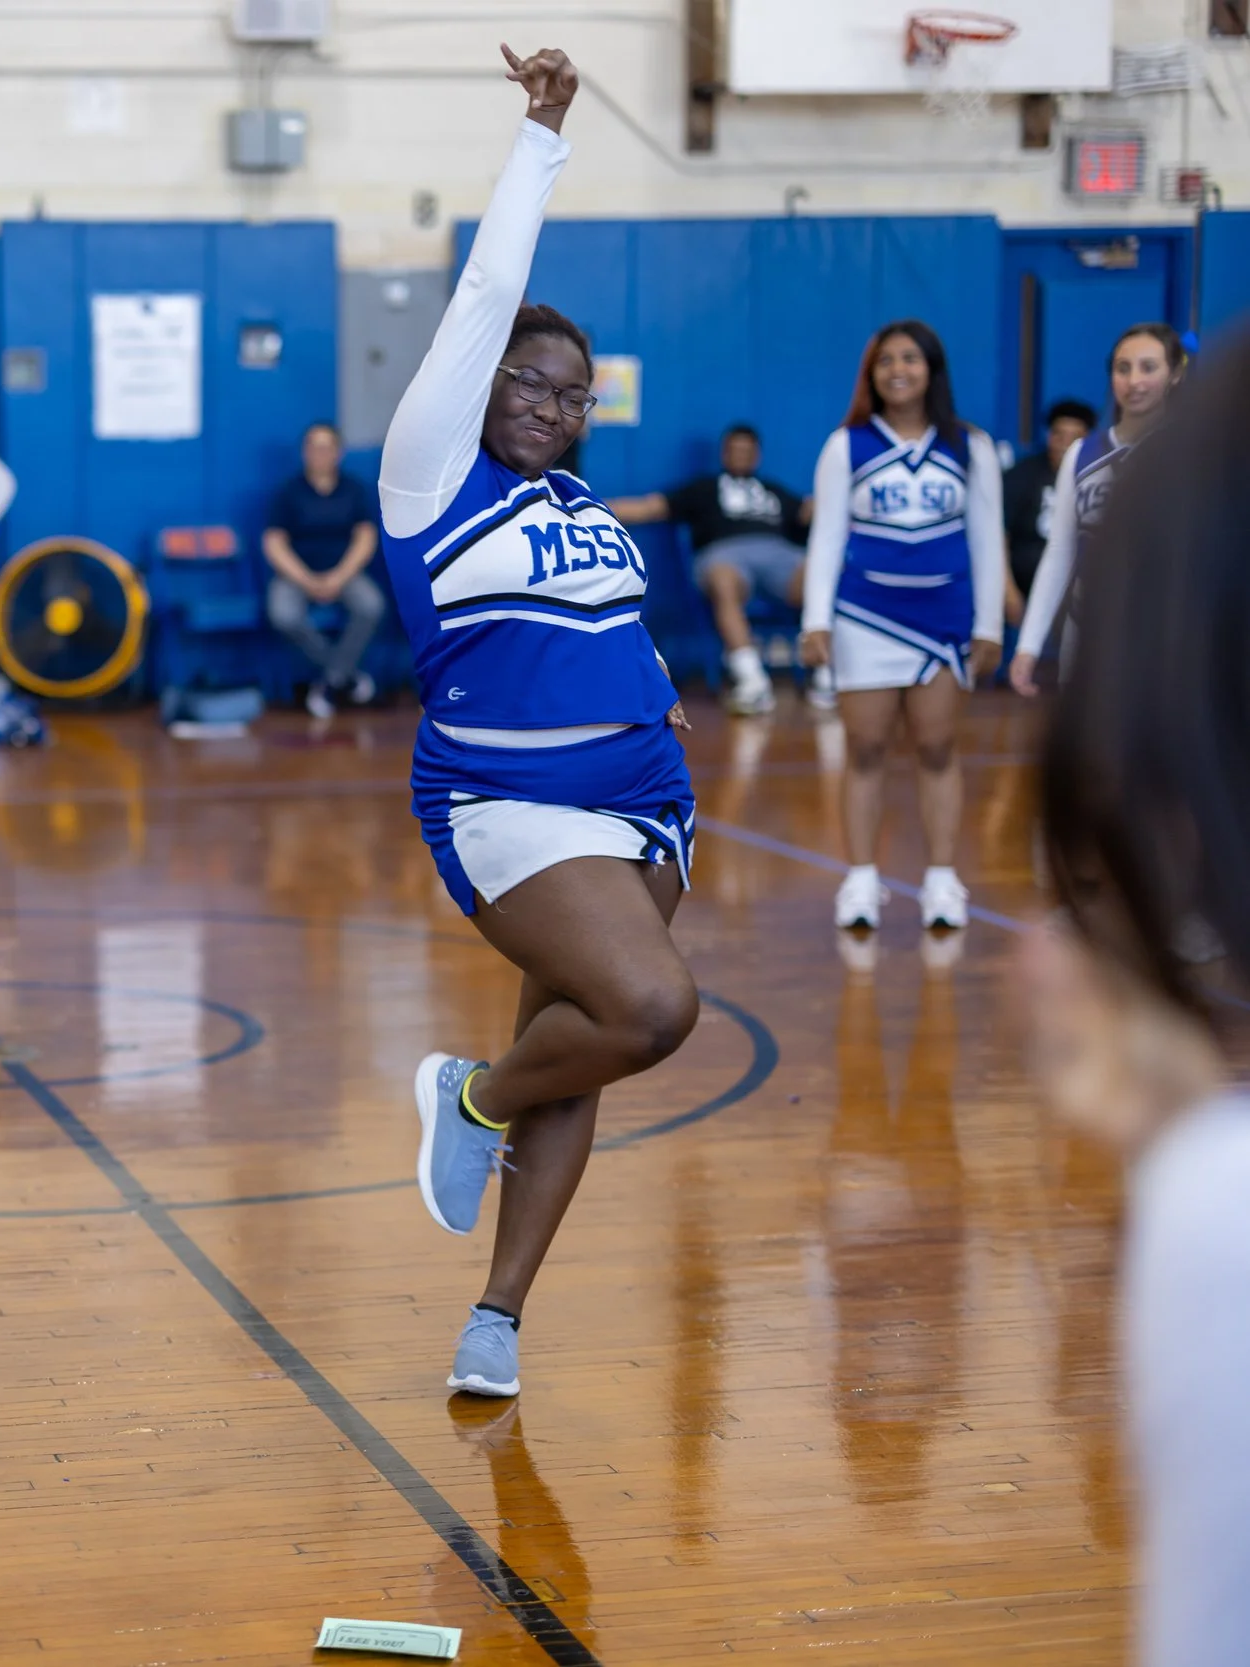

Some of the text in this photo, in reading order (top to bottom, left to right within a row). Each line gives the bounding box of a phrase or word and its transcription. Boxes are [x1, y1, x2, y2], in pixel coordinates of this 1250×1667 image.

[871, 481, 957, 514] MS 50
[346, 1636, 372, 1646] SEE
